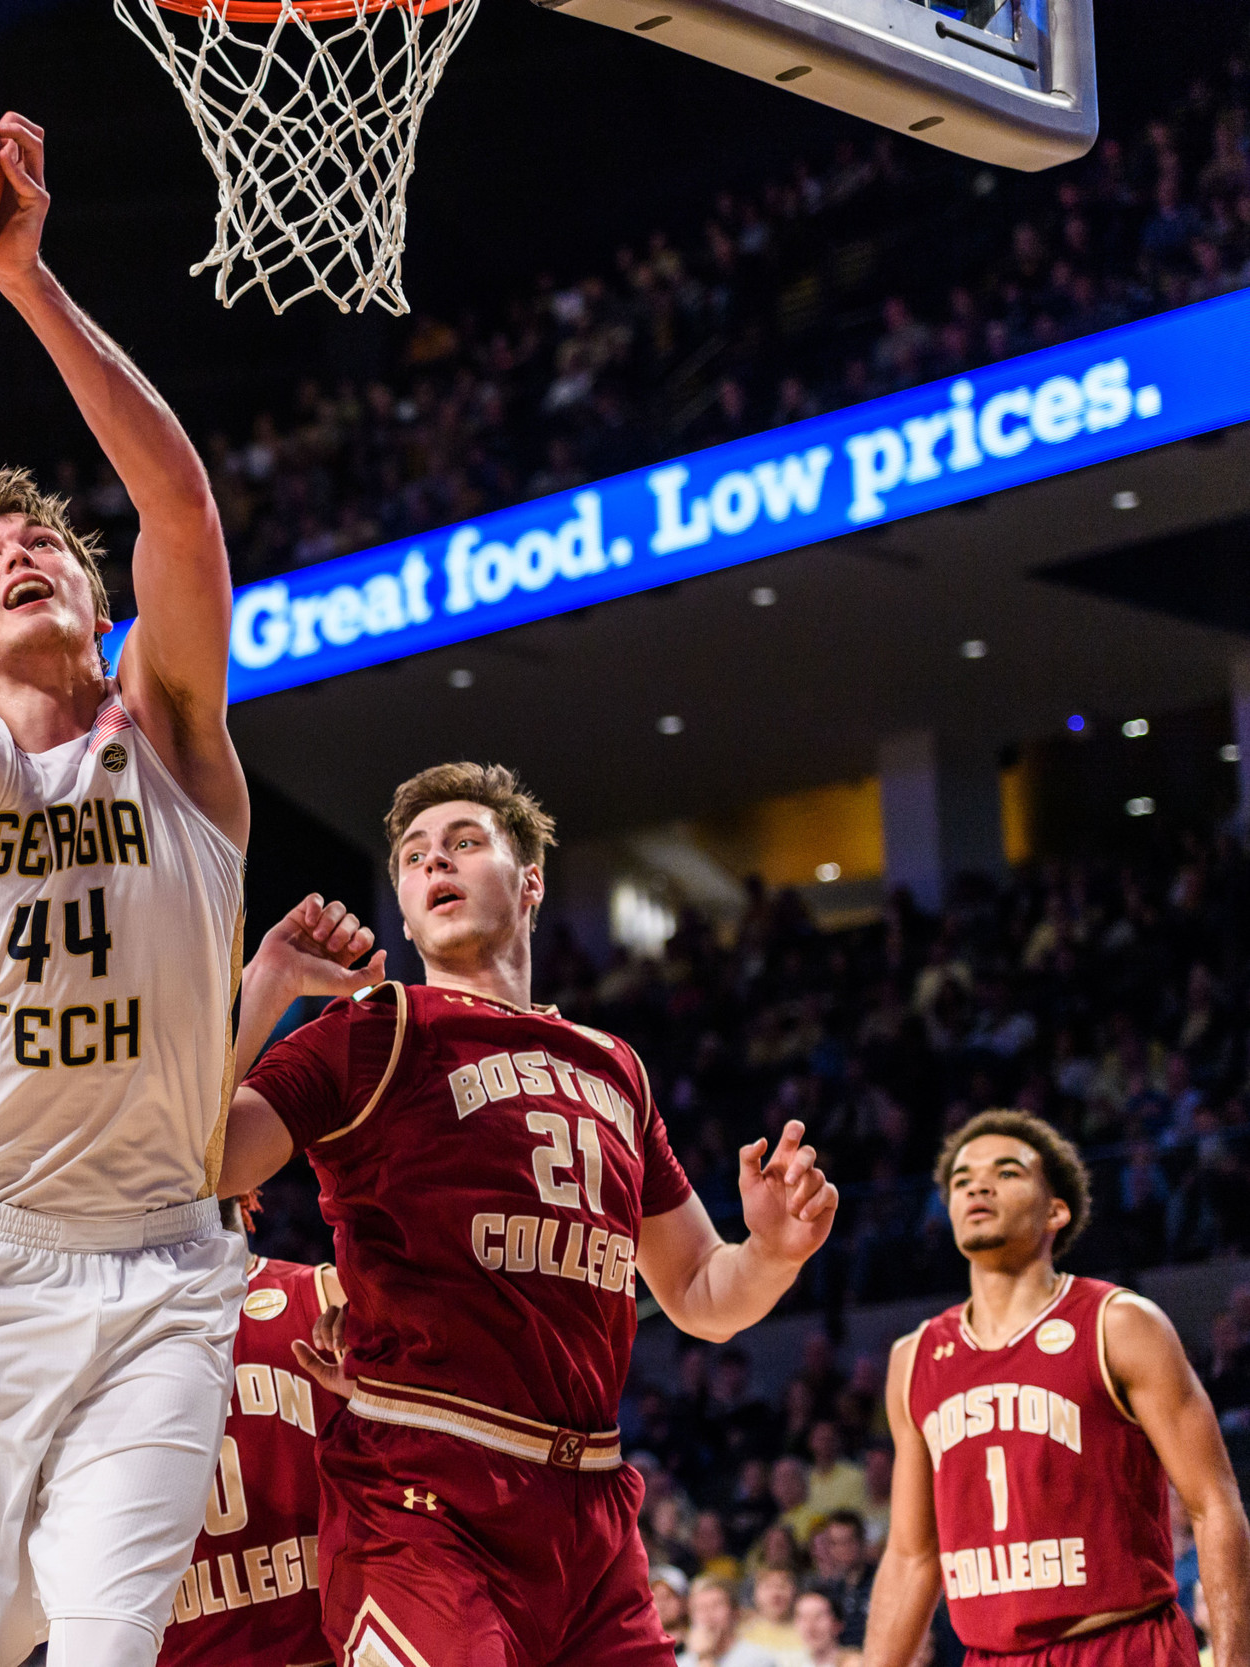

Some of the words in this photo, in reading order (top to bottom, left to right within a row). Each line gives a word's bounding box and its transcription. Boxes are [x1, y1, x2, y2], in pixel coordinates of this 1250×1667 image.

[231, 550, 431, 669] Great
[445, 490, 632, 614] food.
[647, 445, 832, 556] Low
[845, 357, 1162, 524] prices.
[7, 886, 113, 985] 44
[448, 1050, 639, 1160] BOSTON
[526, 1111, 605, 1215] 21
[922, 1382, 1082, 1474] BOSTON
[986, 1445, 1008, 1532] 1
[165, 1536, 318, 1627] OLLEG
[940, 1537, 1087, 1600] COLLEGE
